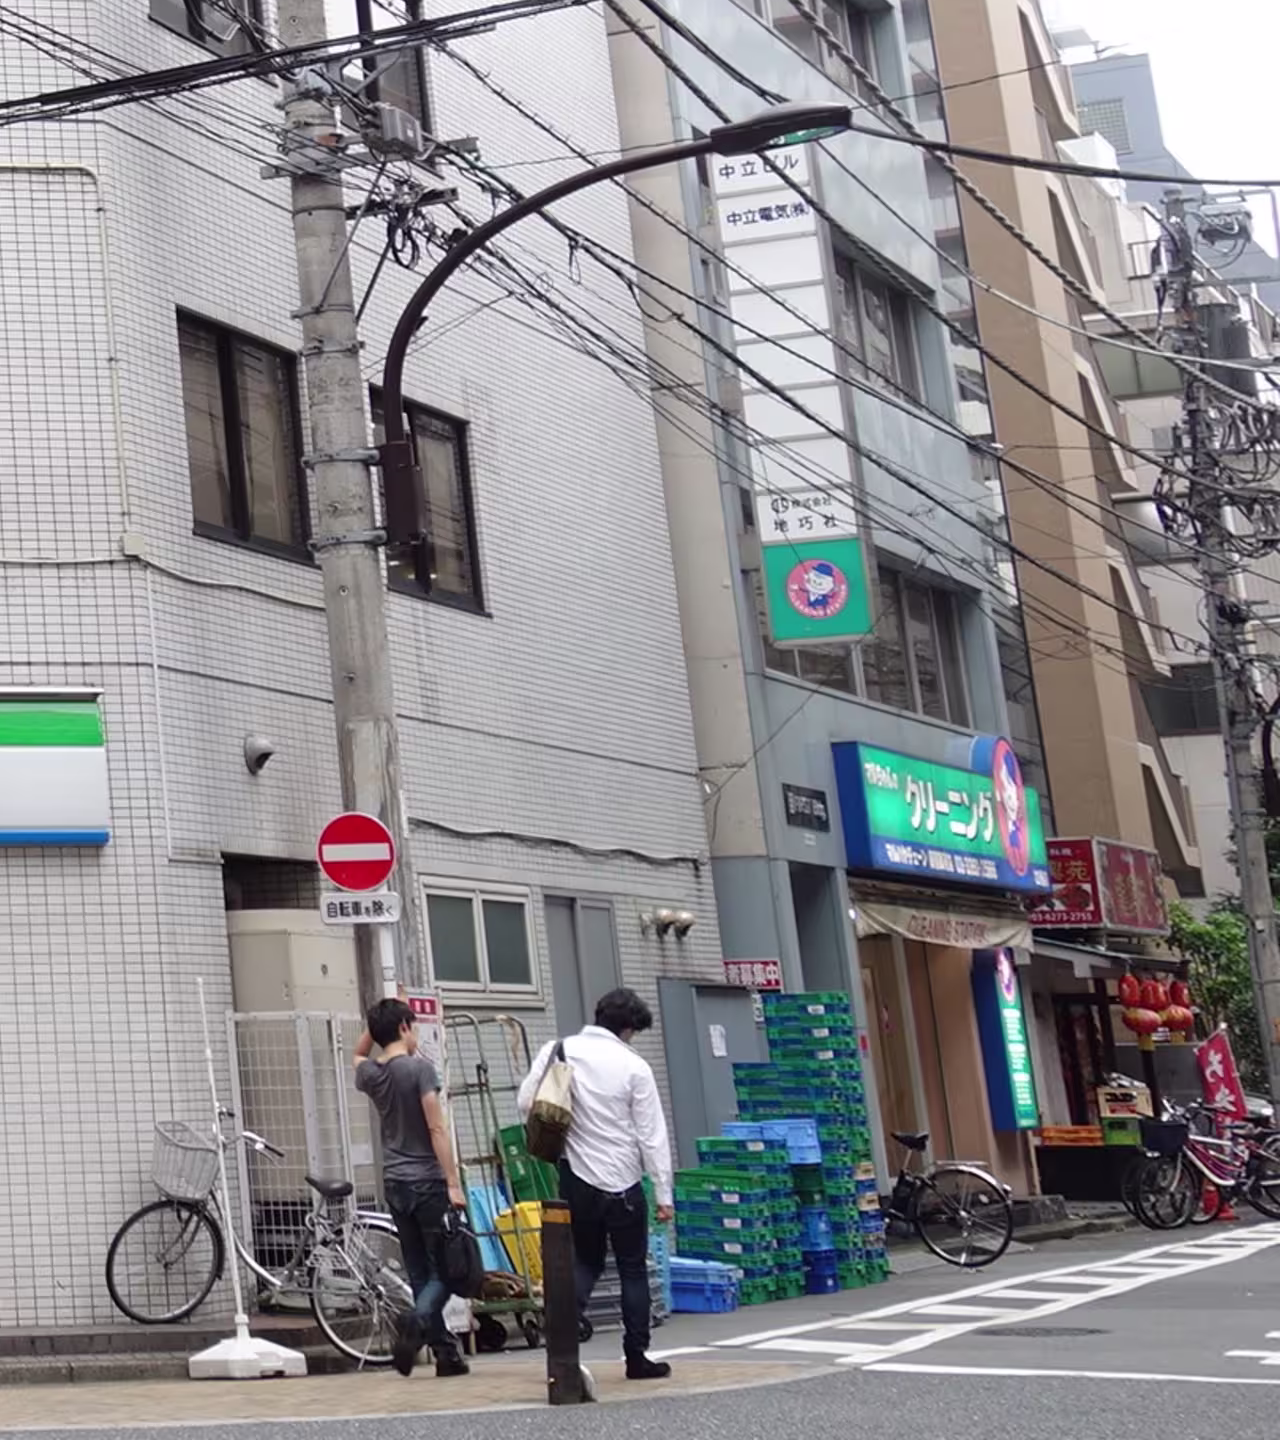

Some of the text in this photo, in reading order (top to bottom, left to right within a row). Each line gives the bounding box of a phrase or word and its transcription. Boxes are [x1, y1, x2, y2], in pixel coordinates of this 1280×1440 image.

[719, 154, 799, 178] 中立ビル
[905, 774, 994, 843] クリーニング
[327, 900, 394, 919] 自転車を除く
